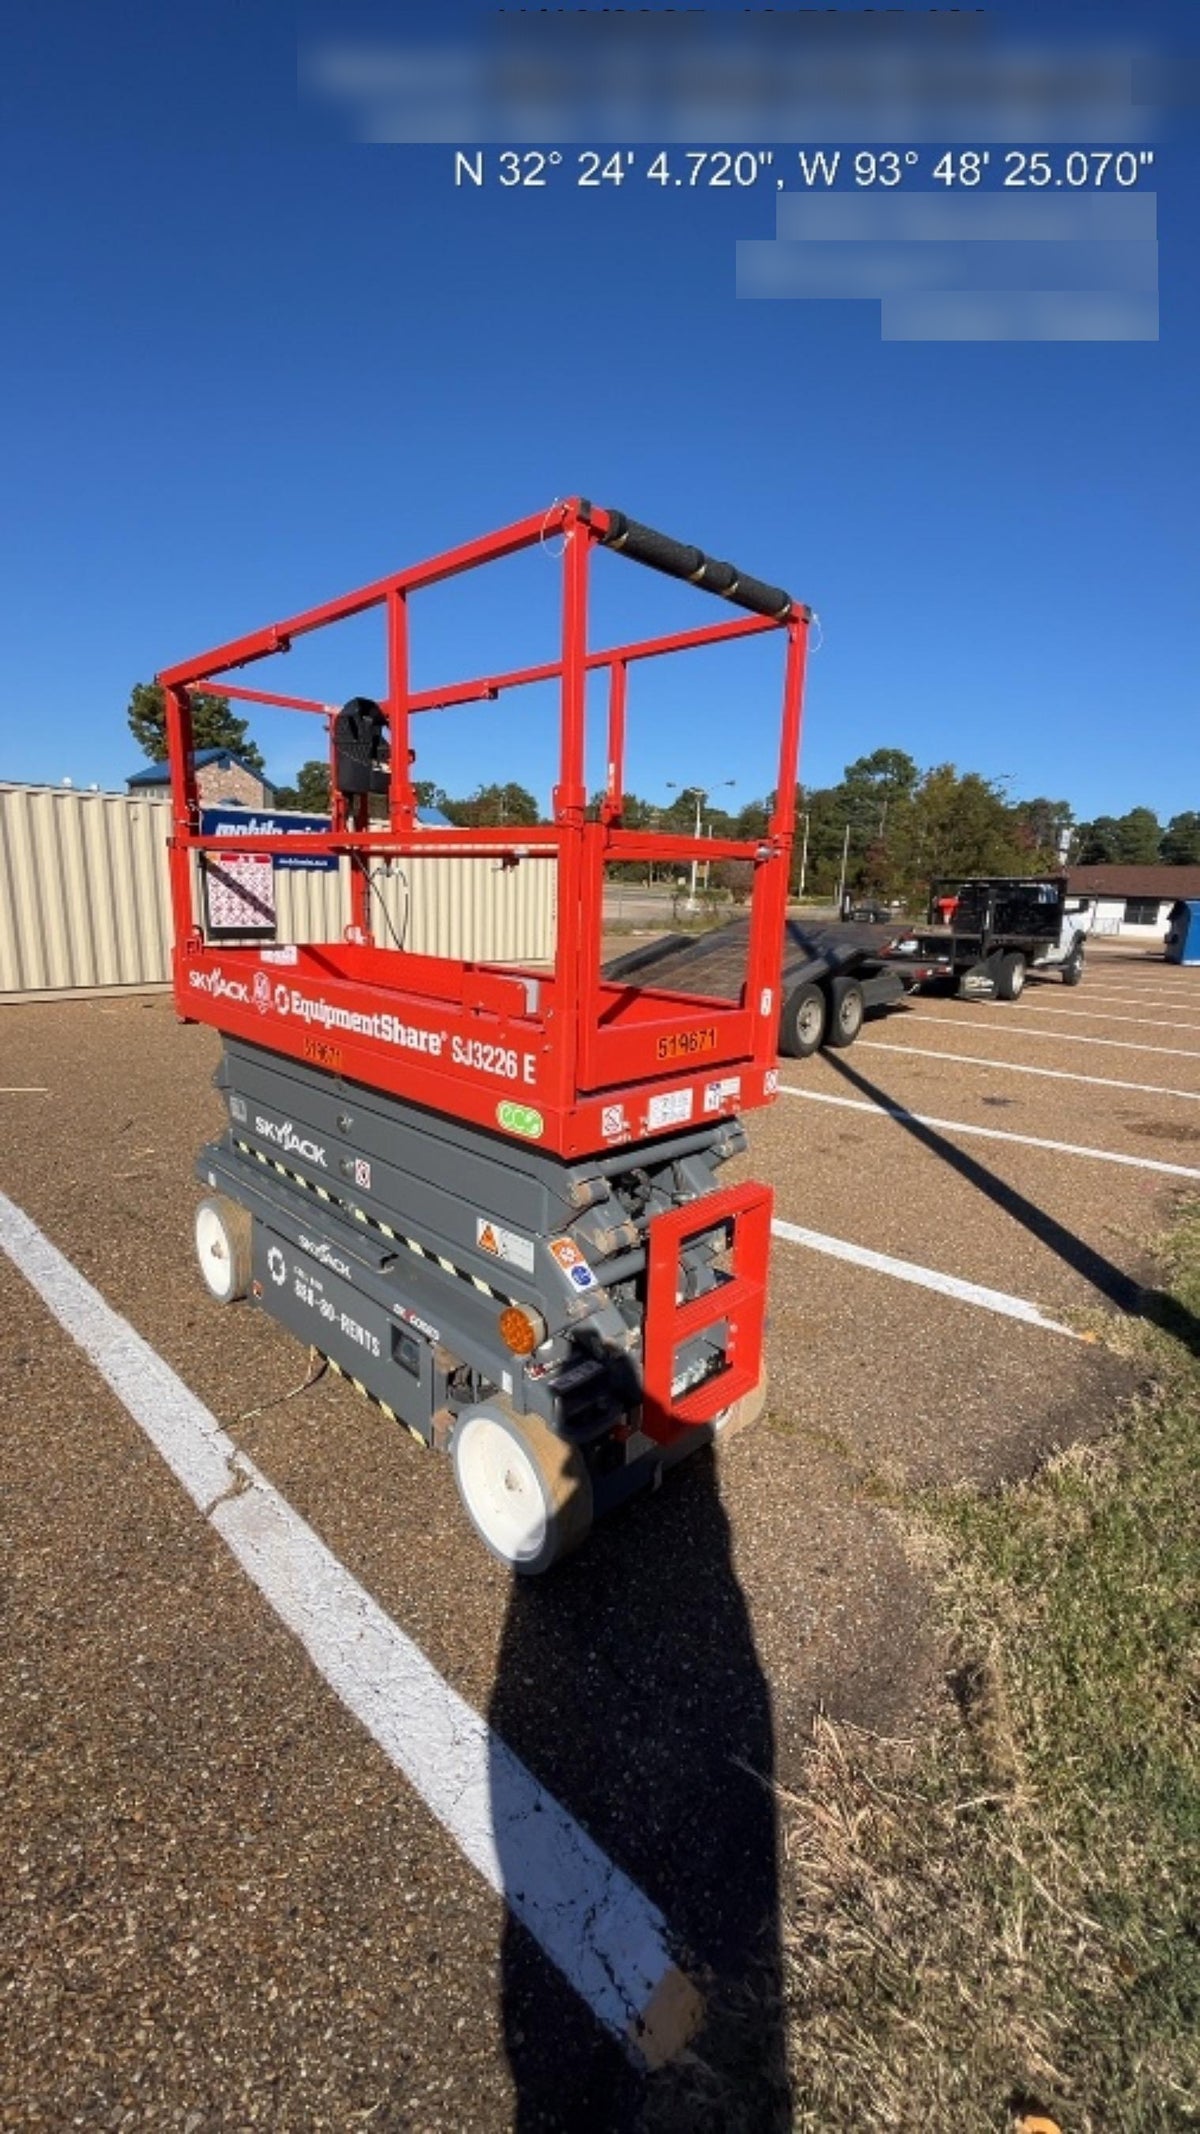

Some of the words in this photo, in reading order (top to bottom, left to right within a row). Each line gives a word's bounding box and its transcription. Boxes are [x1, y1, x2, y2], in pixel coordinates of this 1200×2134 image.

[188, 967, 250, 1004] SKYJACK
[291, 989, 442, 1056] EquipmentShare
[452, 1035, 517, 1080] SJ3226
[523, 1053, 537, 1085] E
[658, 1028, 716, 1059] 519671
[255, 1115, 328, 1168] SKYJACK
